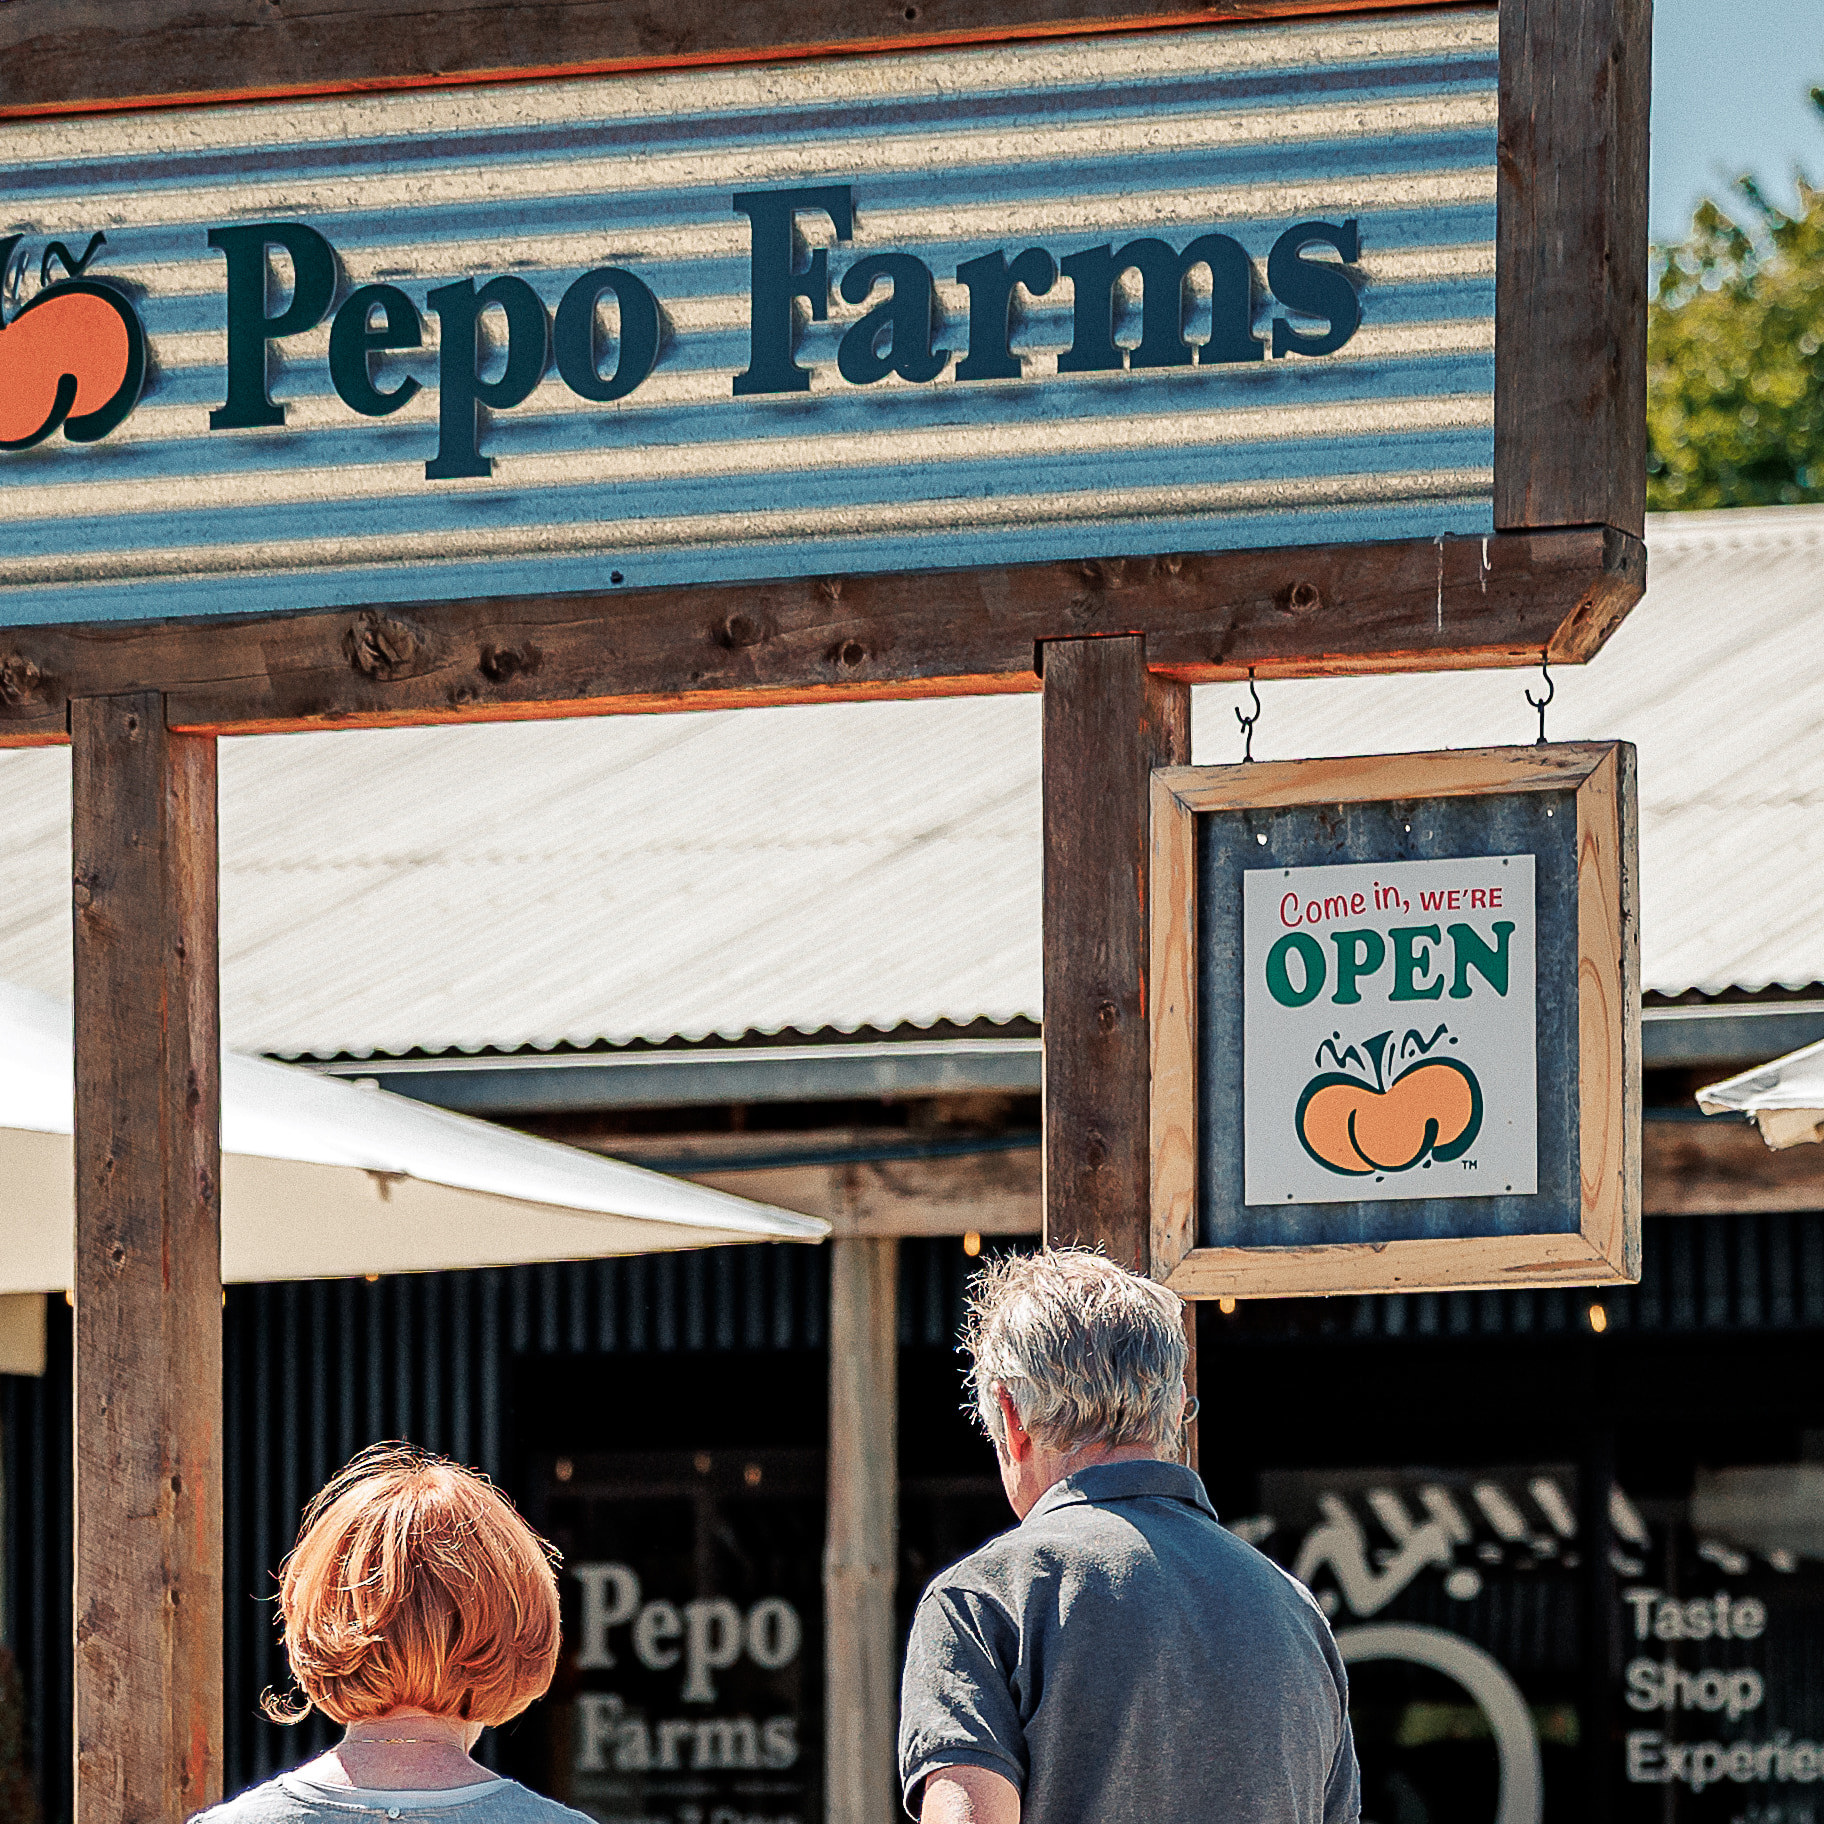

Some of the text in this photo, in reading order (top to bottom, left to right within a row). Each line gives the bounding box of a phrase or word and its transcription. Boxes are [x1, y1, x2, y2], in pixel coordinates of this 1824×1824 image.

[207, 184, 1363, 481] Pepo Farms
[1279, 881, 1503, 928] Come in, WE'RE
[1265, 920, 1516, 1008] OPEN
[1461, 1159, 1478, 1170] TM
[572, 1562, 802, 1702] Pepo
[1624, 1588, 1766, 1640] Taste
[1626, 1658, 1764, 1722] Shop
[575, 1692, 800, 1770] Farms
